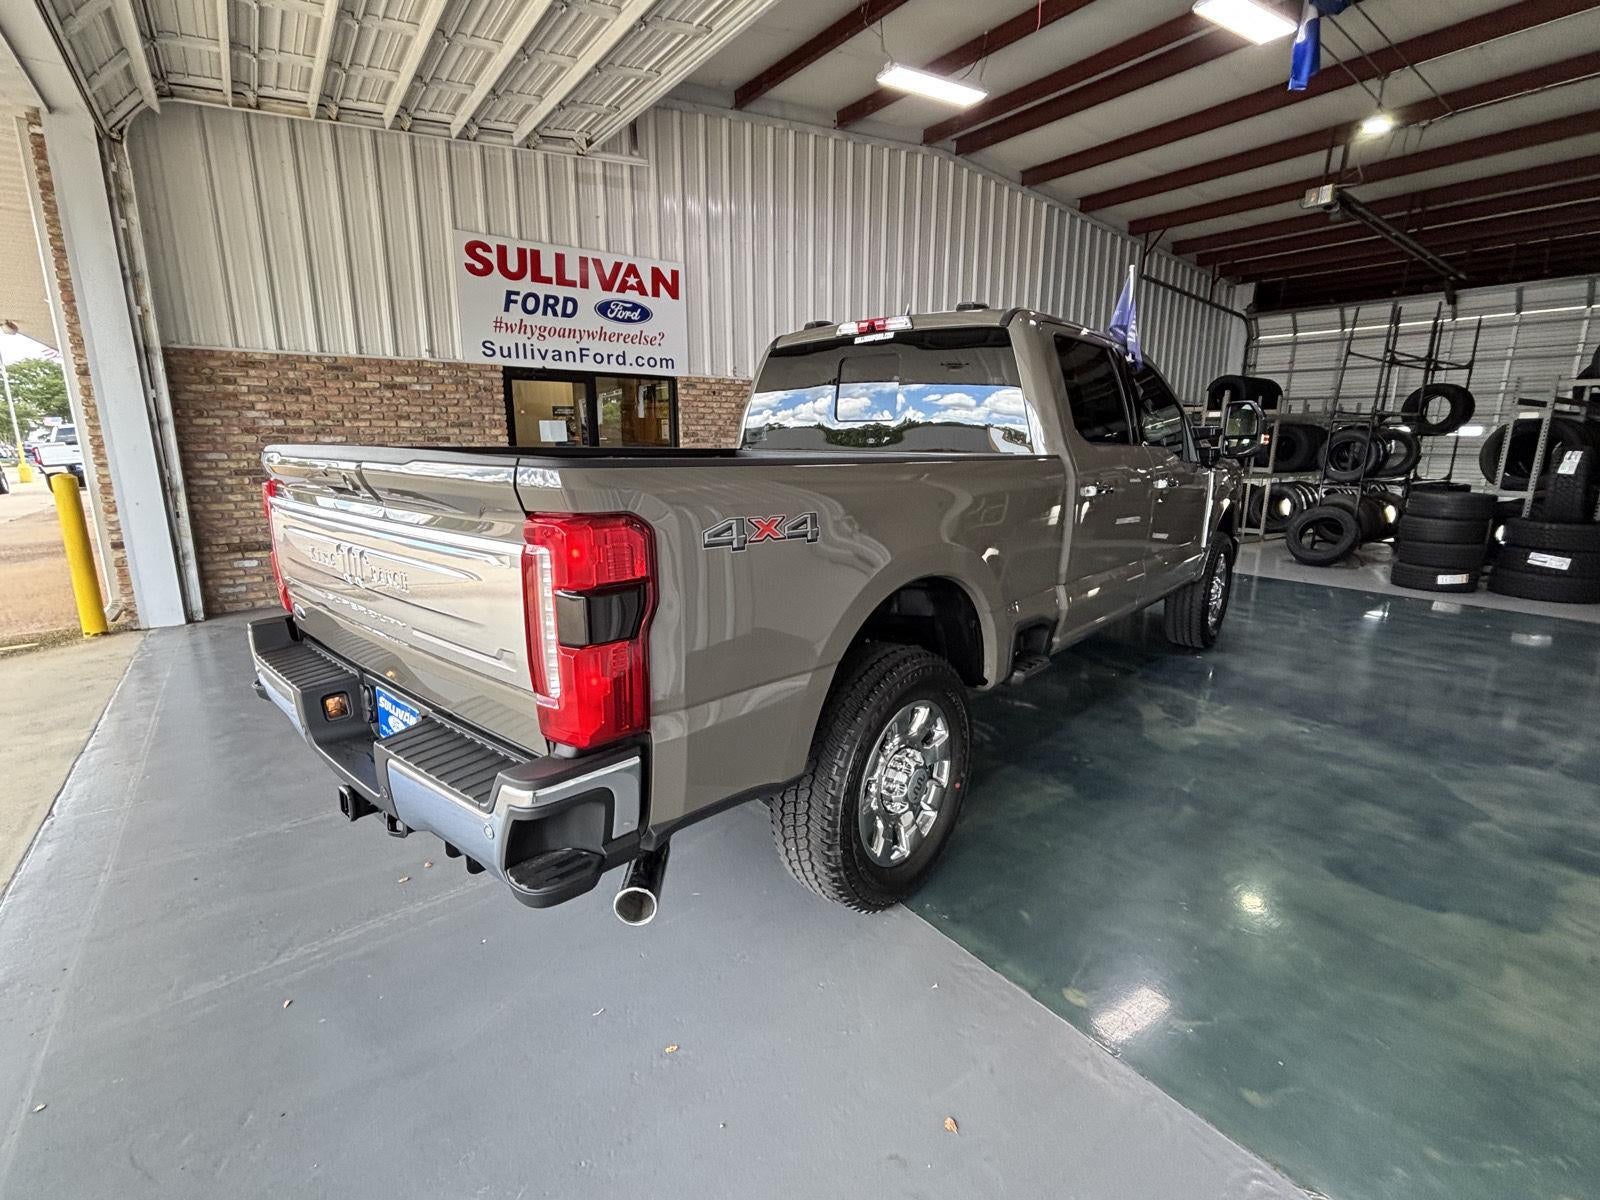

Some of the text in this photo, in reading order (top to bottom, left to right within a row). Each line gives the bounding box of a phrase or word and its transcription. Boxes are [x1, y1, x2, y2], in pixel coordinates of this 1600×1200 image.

[464, 239, 680, 300] SULLIVAN
[503, 289, 579, 319] FORD
[607, 300, 642, 321] Ford
[492, 316, 665, 347] #whygoanywhereelse?
[481, 340, 675, 369] SullivanFord.com
